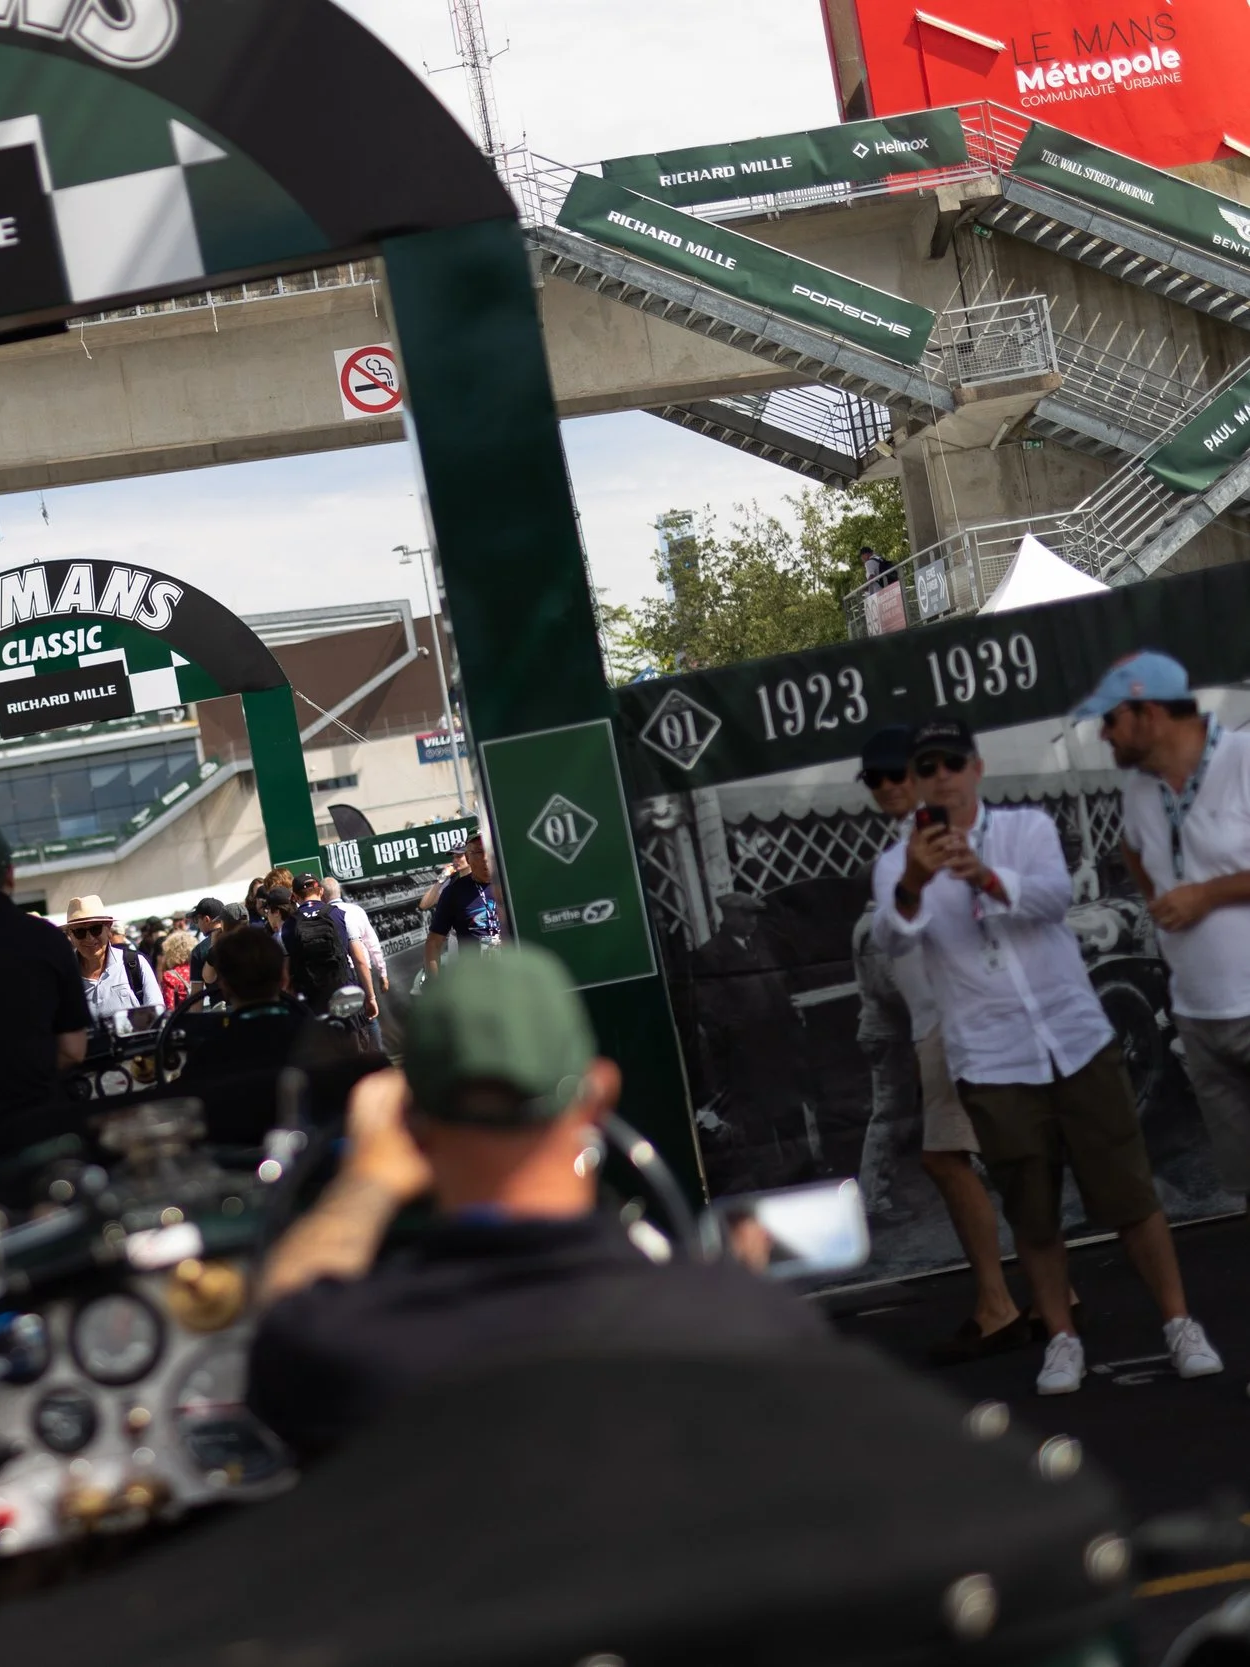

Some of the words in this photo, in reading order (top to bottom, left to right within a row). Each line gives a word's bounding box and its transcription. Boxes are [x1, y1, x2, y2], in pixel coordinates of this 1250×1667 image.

[1011, 32, 1054, 66] LE
[1073, 13, 1177, 56] MANS
[1016, 46, 1181, 93] Métropole
[1021, 81, 1116, 108] COMMUNAUTÉ
[1123, 72, 1182, 91] URBAINE
[875, 137, 929, 155] Helinox
[660, 164, 736, 187] RICHARD
[741, 156, 793, 175] MILLE
[1040, 149, 1059, 167] THE
[1059, 159, 1083, 177] WALL
[1082, 167, 1117, 190] STREET
[1116, 180, 1155, 205] JOURNAL
[607, 210, 682, 249] RICHARD
[685, 239, 737, 271] MILLE
[1212, 234, 1250, 258] BENT
[792, 284, 912, 339] PORSCHE
[1203, 423, 1237, 452] PAUL
[0, 564, 184, 631] MANS
[2, 625, 102, 665] CLASSIC
[6, 692, 70, 715] RICHARD
[73, 684, 117, 703] MILLE
[757, 666, 869, 741] 1923
[926, 634, 1038, 707] 1939
[542, 909, 581, 924] Sarthe
